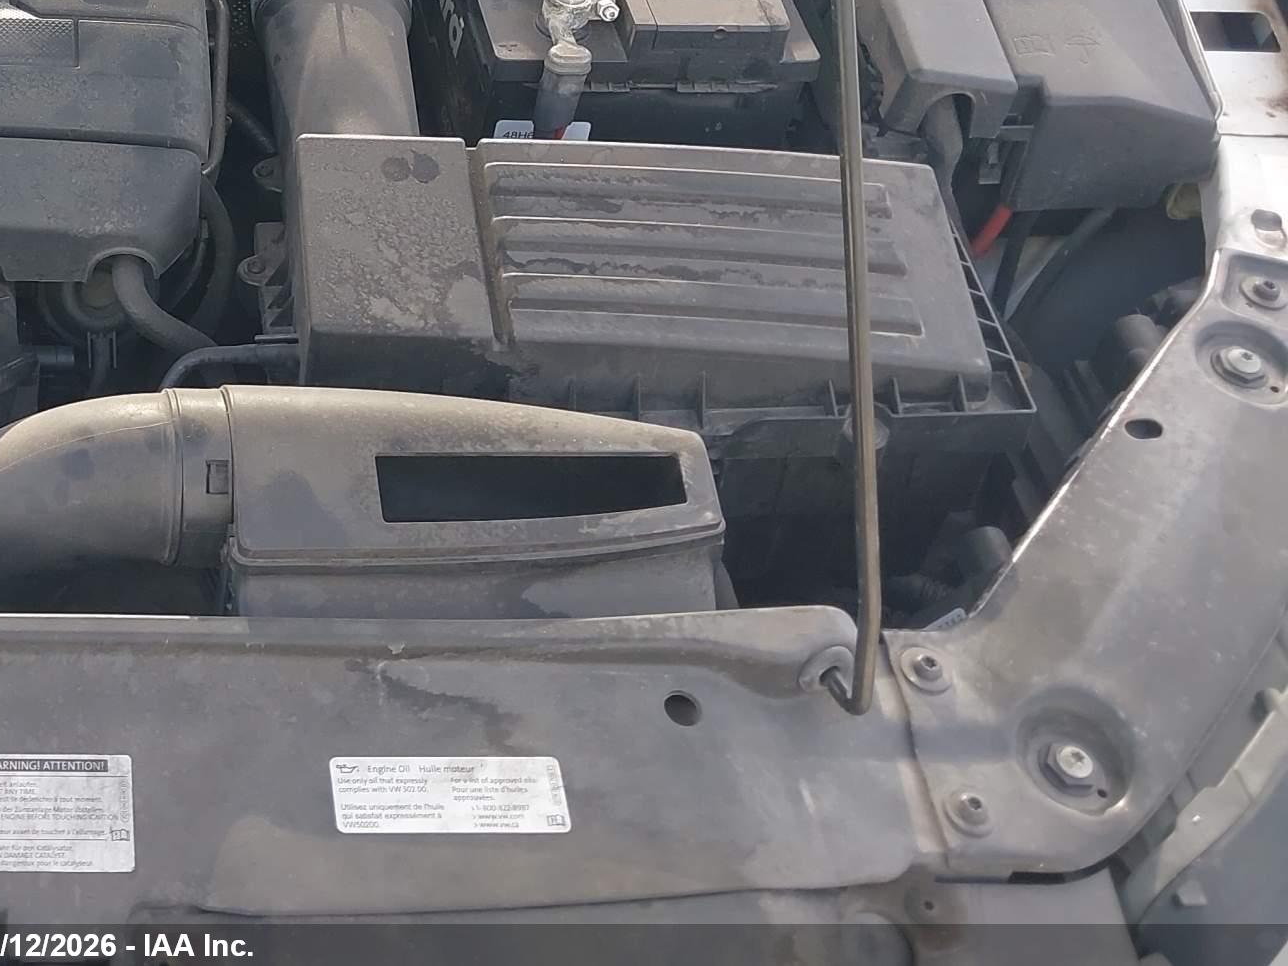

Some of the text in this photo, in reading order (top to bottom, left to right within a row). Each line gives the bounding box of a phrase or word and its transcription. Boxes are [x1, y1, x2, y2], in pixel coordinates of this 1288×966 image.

[43, 761, 104, 771] ATTENTION!
[367, 765, 410, 775] Engine Oil
[418, 765, 441, 773] Huile
